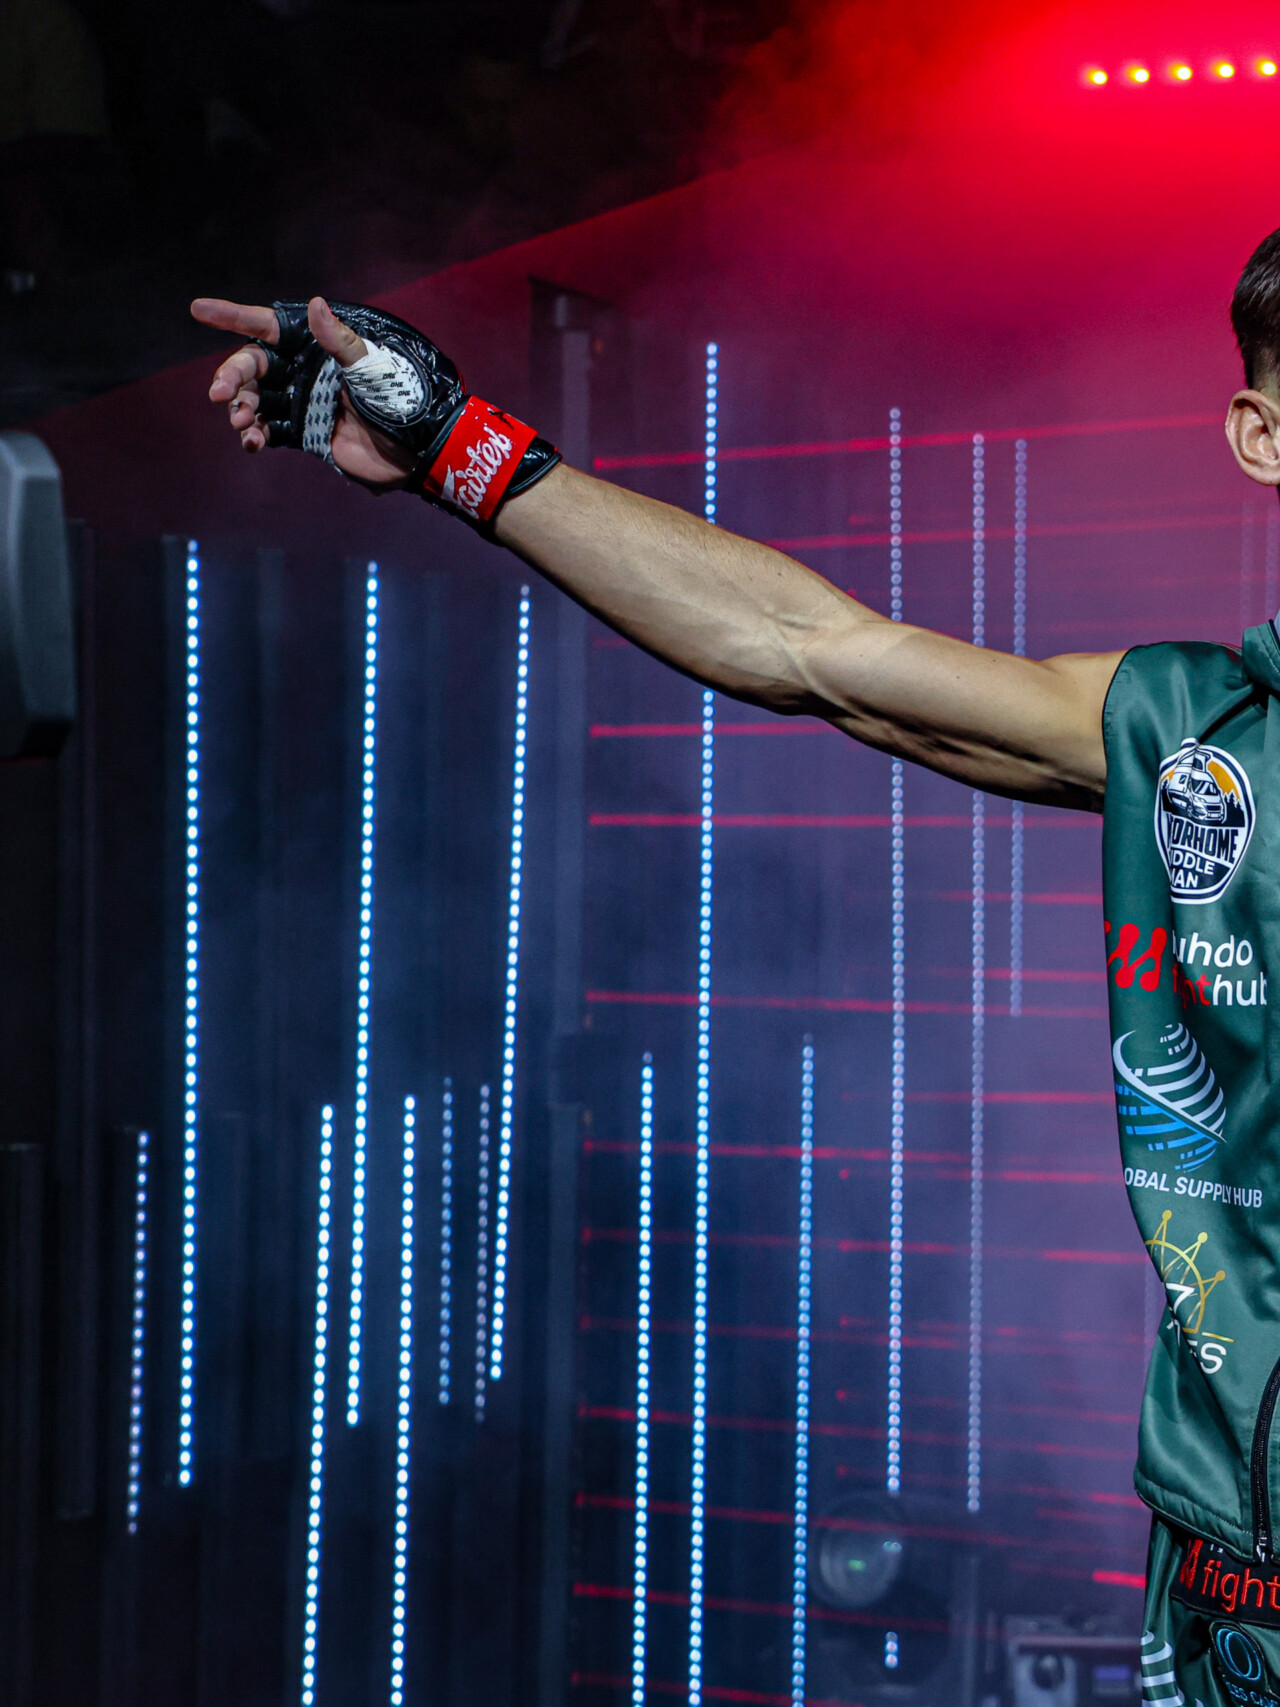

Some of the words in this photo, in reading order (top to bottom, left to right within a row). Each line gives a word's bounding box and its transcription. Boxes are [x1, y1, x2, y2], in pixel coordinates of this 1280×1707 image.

[1167, 813, 1238, 864] ORHOME
[1124, 1167, 1169, 1192] OBAL
[1174, 1176, 1232, 1204] SUPPLY
[1233, 1187, 1262, 1208] HUB
